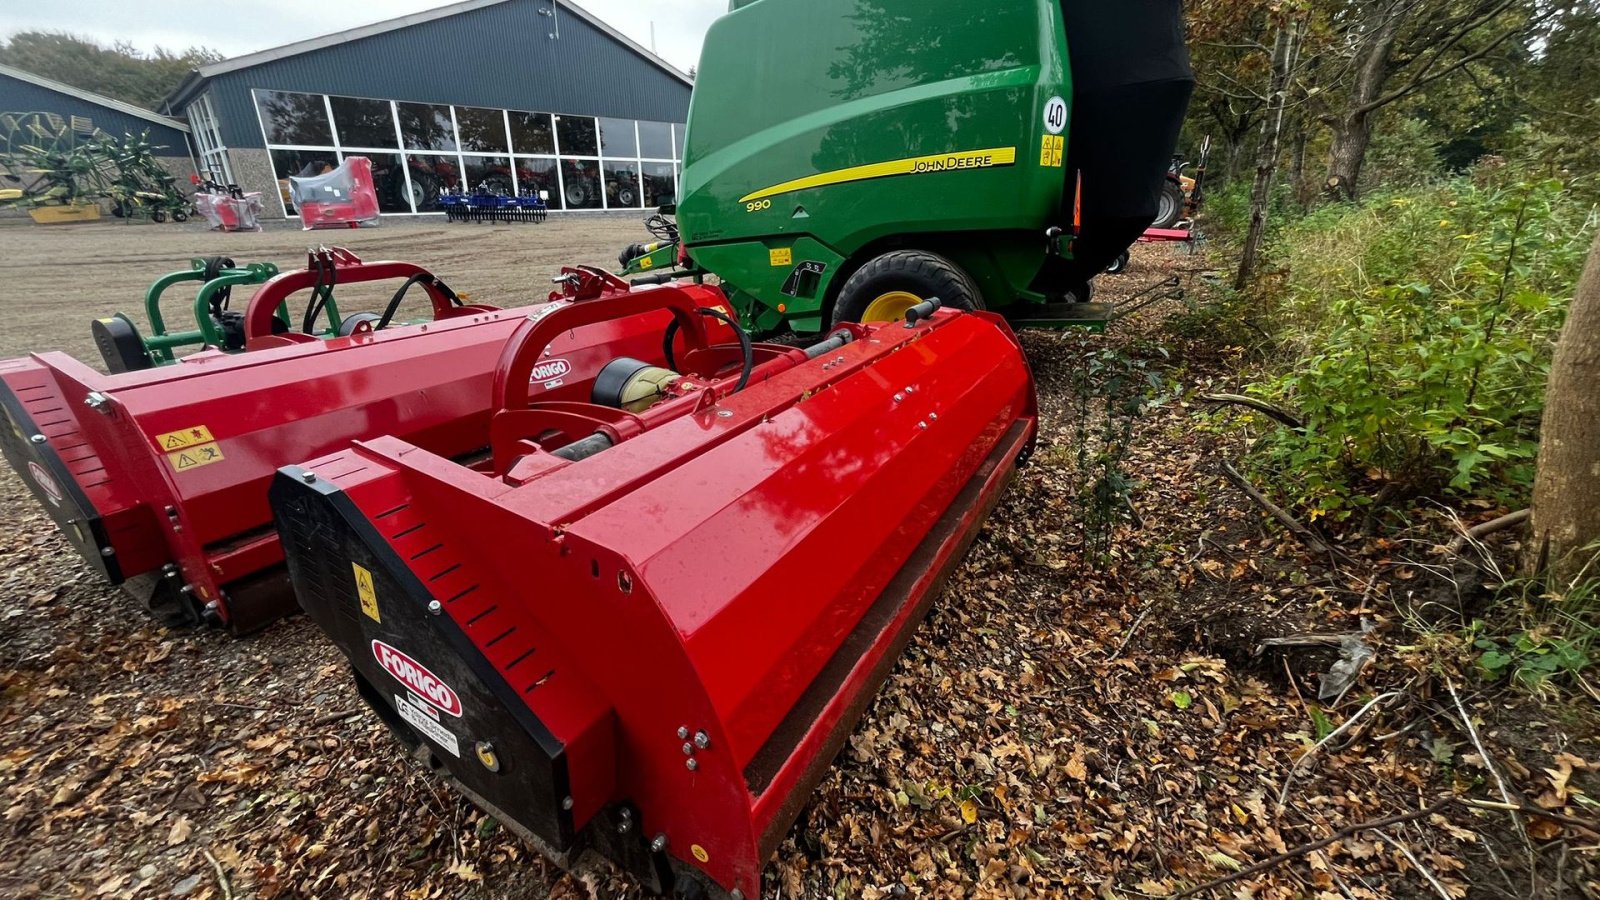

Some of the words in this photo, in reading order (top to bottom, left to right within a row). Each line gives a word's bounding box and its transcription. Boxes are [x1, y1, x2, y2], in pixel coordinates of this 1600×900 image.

[1048, 103, 1063, 127] 40
[910, 160, 945, 173] JOHN
[946, 155, 992, 169] DEERE
[746, 199, 771, 212] 990
[530, 361, 566, 380] ORIGO
[380, 644, 453, 709] FORIGO
